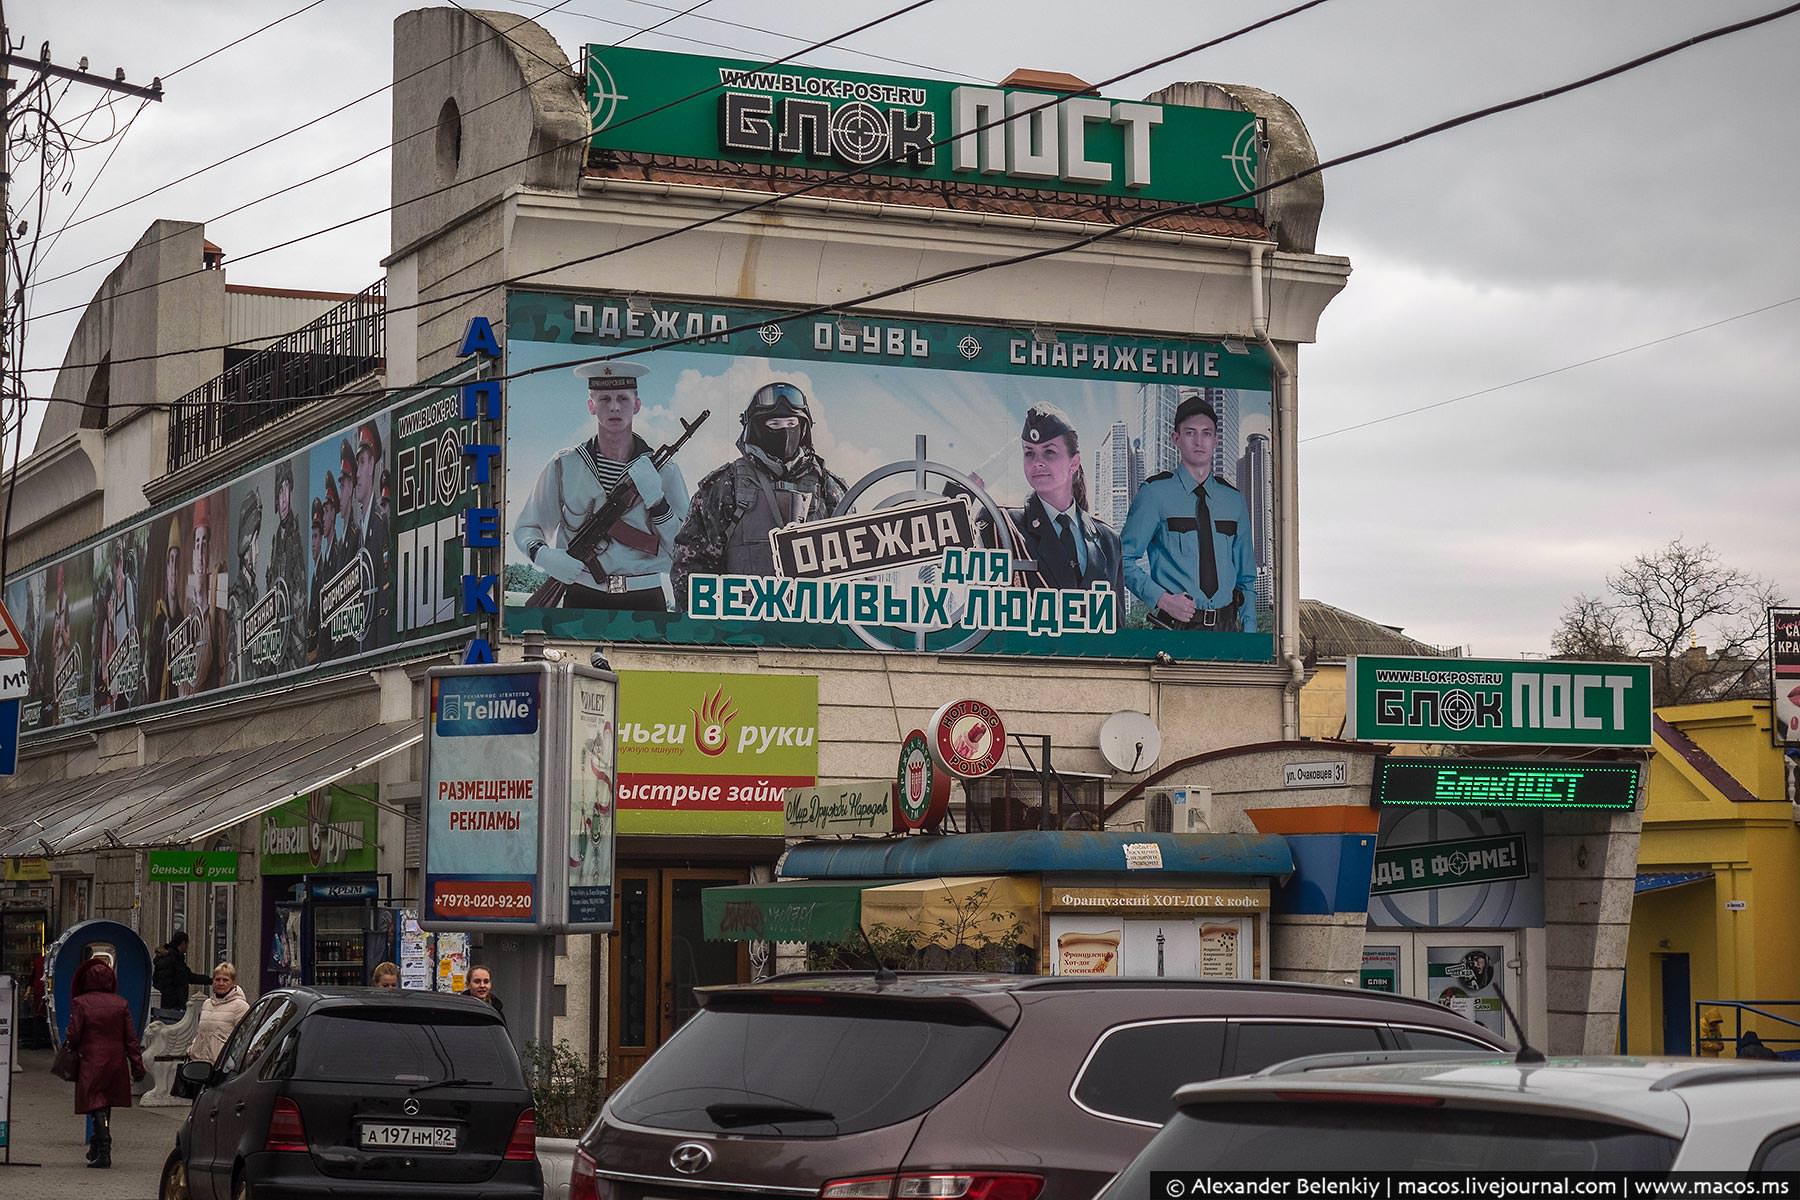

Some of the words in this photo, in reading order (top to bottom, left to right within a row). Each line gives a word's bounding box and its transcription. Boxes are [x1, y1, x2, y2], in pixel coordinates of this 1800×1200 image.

[719, 68, 926, 106] WWW.BLOK-POST.RU
[722, 91, 935, 168] БЛОК
[952, 86, 1163, 188] ПОСТ
[574, 304, 729, 344] ОДЕЖДА
[814, 322, 929, 357] ОБУВЬ
[1010, 339, 1220, 377] СНАРЯЖЕНИЕ
[399, 394, 459, 439] WWW.BLOK-PO
[791, 508, 961, 575] ОДЕЖДА
[942, 547, 1014, 586] ДЛЯ
[688, 574, 953, 629] ВЕЖЛИВЫХ
[963, 581, 1117, 637] ЛЮДЕЙ
[1376, 669, 1503, 685] WWW.BLOK-POST.RU
[464, 700, 529, 720] TellMe
[1376, 688, 1503, 731] БЛОК
[1511, 672, 1633, 731] ПОСТ
[943, 703, 967, 729] HOT
[971, 703, 999, 728] DOG
[704, 725, 721, 744] в
[737, 725, 815, 753] руки
[949, 754, 996, 774] POINT
[1286, 768, 1297, 783] ул.
[1335, 764, 1344, 780] 31
[438, 779, 534, 802] РАЗМЕЩЕНИЕ
[727, 780, 792, 802] займ
[450, 811, 520, 831] РЕКЛАМЫ
[263, 815, 308, 856] деньги
[152, 863, 191, 876] деньги
[207, 865, 236, 877] руки
[1371, 861, 1405, 886] ДЬ
[1411, 858, 1425, 879] В
[1431, 841, 1518, 877] ФОРМЕ!
[435, 894, 531, 908] +7978-020-92-20
[1062, 894, 1150, 909] Французский
[1152, 894, 1213, 908] ХОТ-ДОГ
[1214, 895, 1225, 907] &
[1227, 896, 1260, 908] кофе
[436, 1129, 451, 1141] 92
